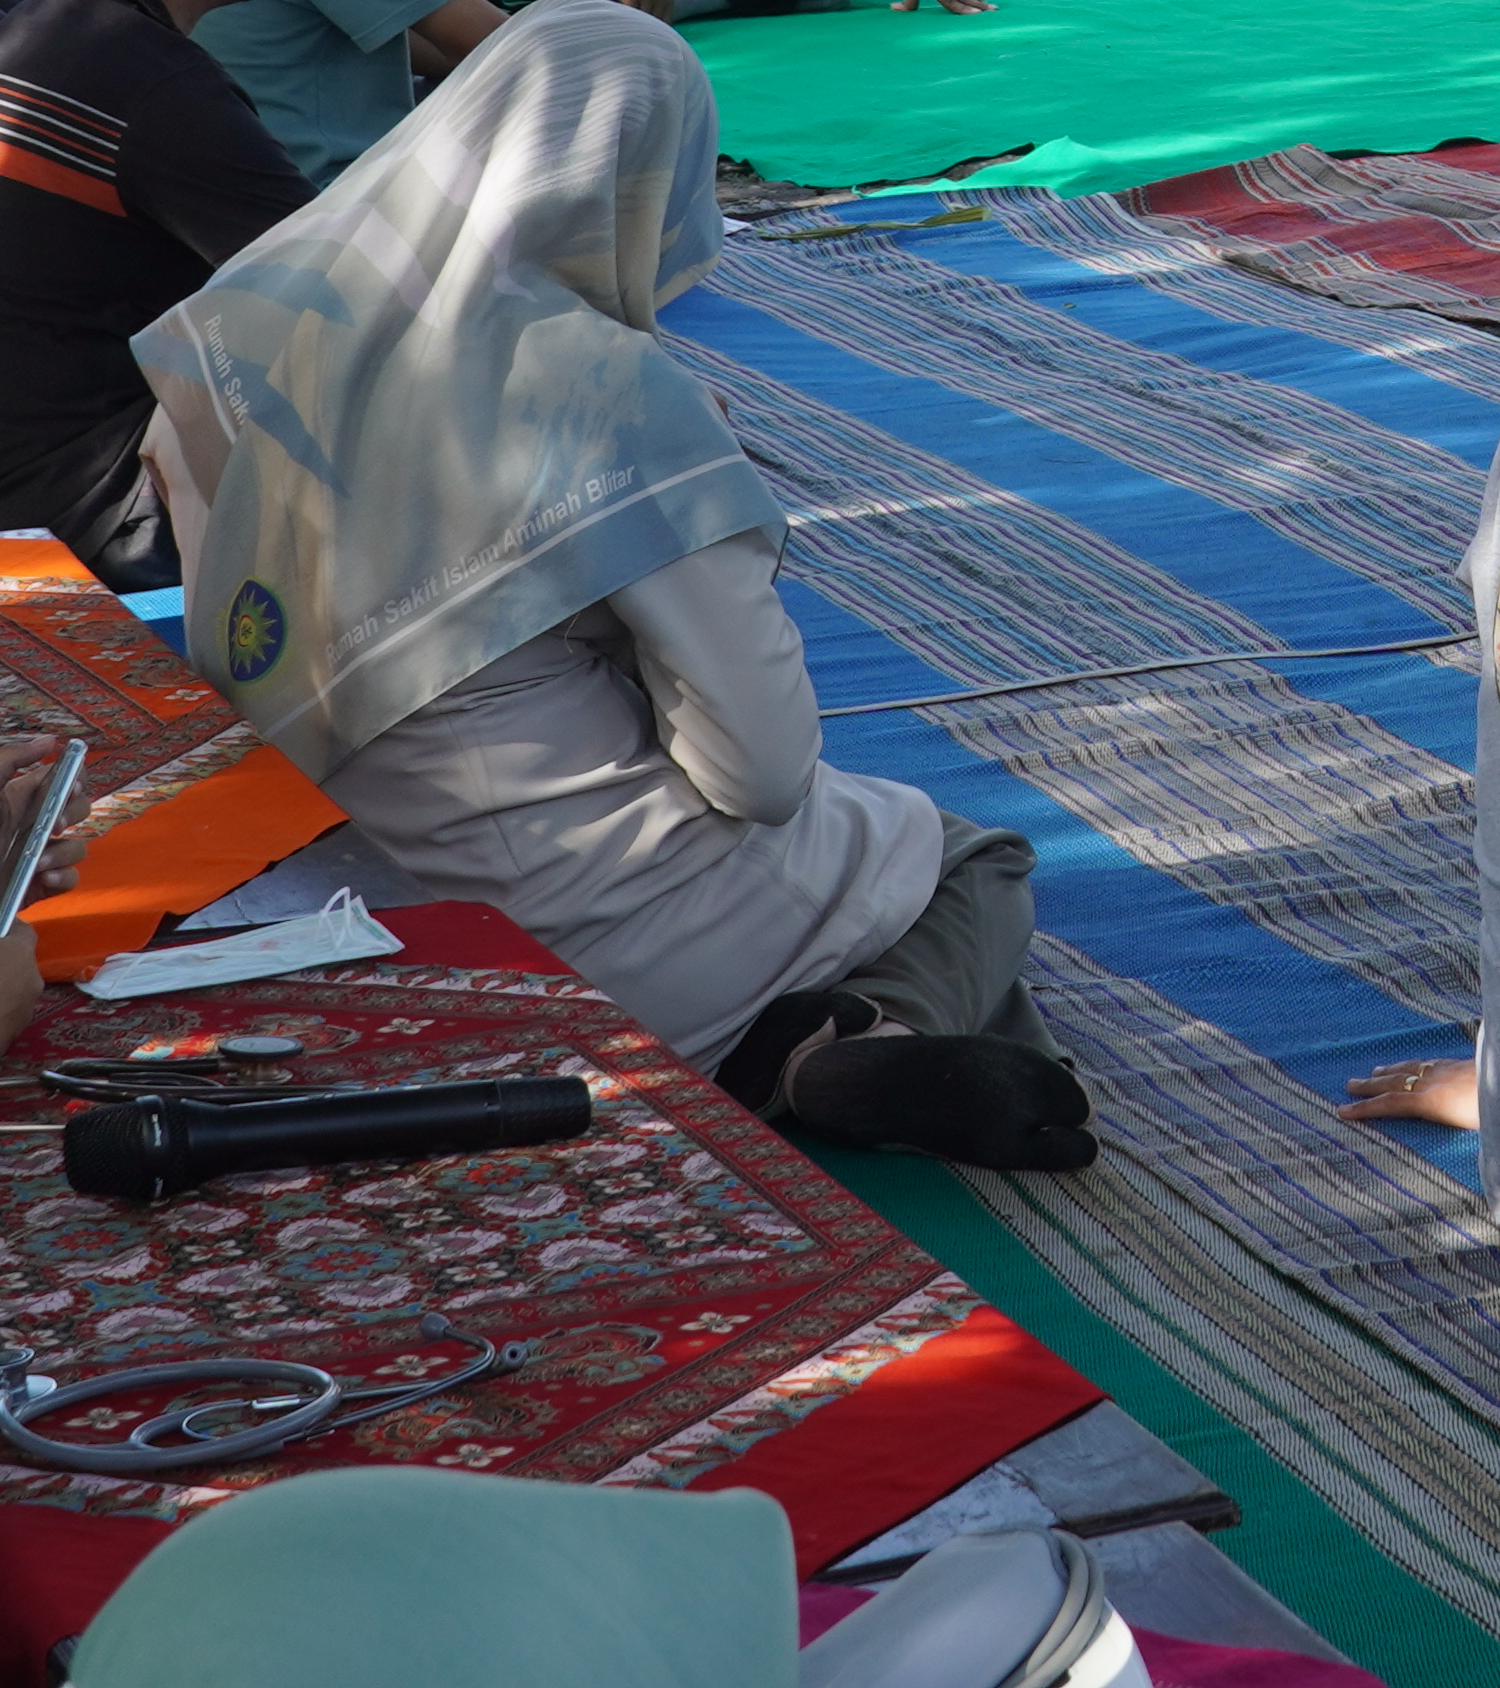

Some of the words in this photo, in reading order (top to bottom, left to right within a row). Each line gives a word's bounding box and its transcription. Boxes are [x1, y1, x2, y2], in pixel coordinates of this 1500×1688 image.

[325, 614, 380, 666] Rumah
[383, 575, 440, 624] Sakit
[442, 541, 501, 590] Islam
[503, 491, 583, 554] Aminah
[585, 465, 635, 504] Blitar
